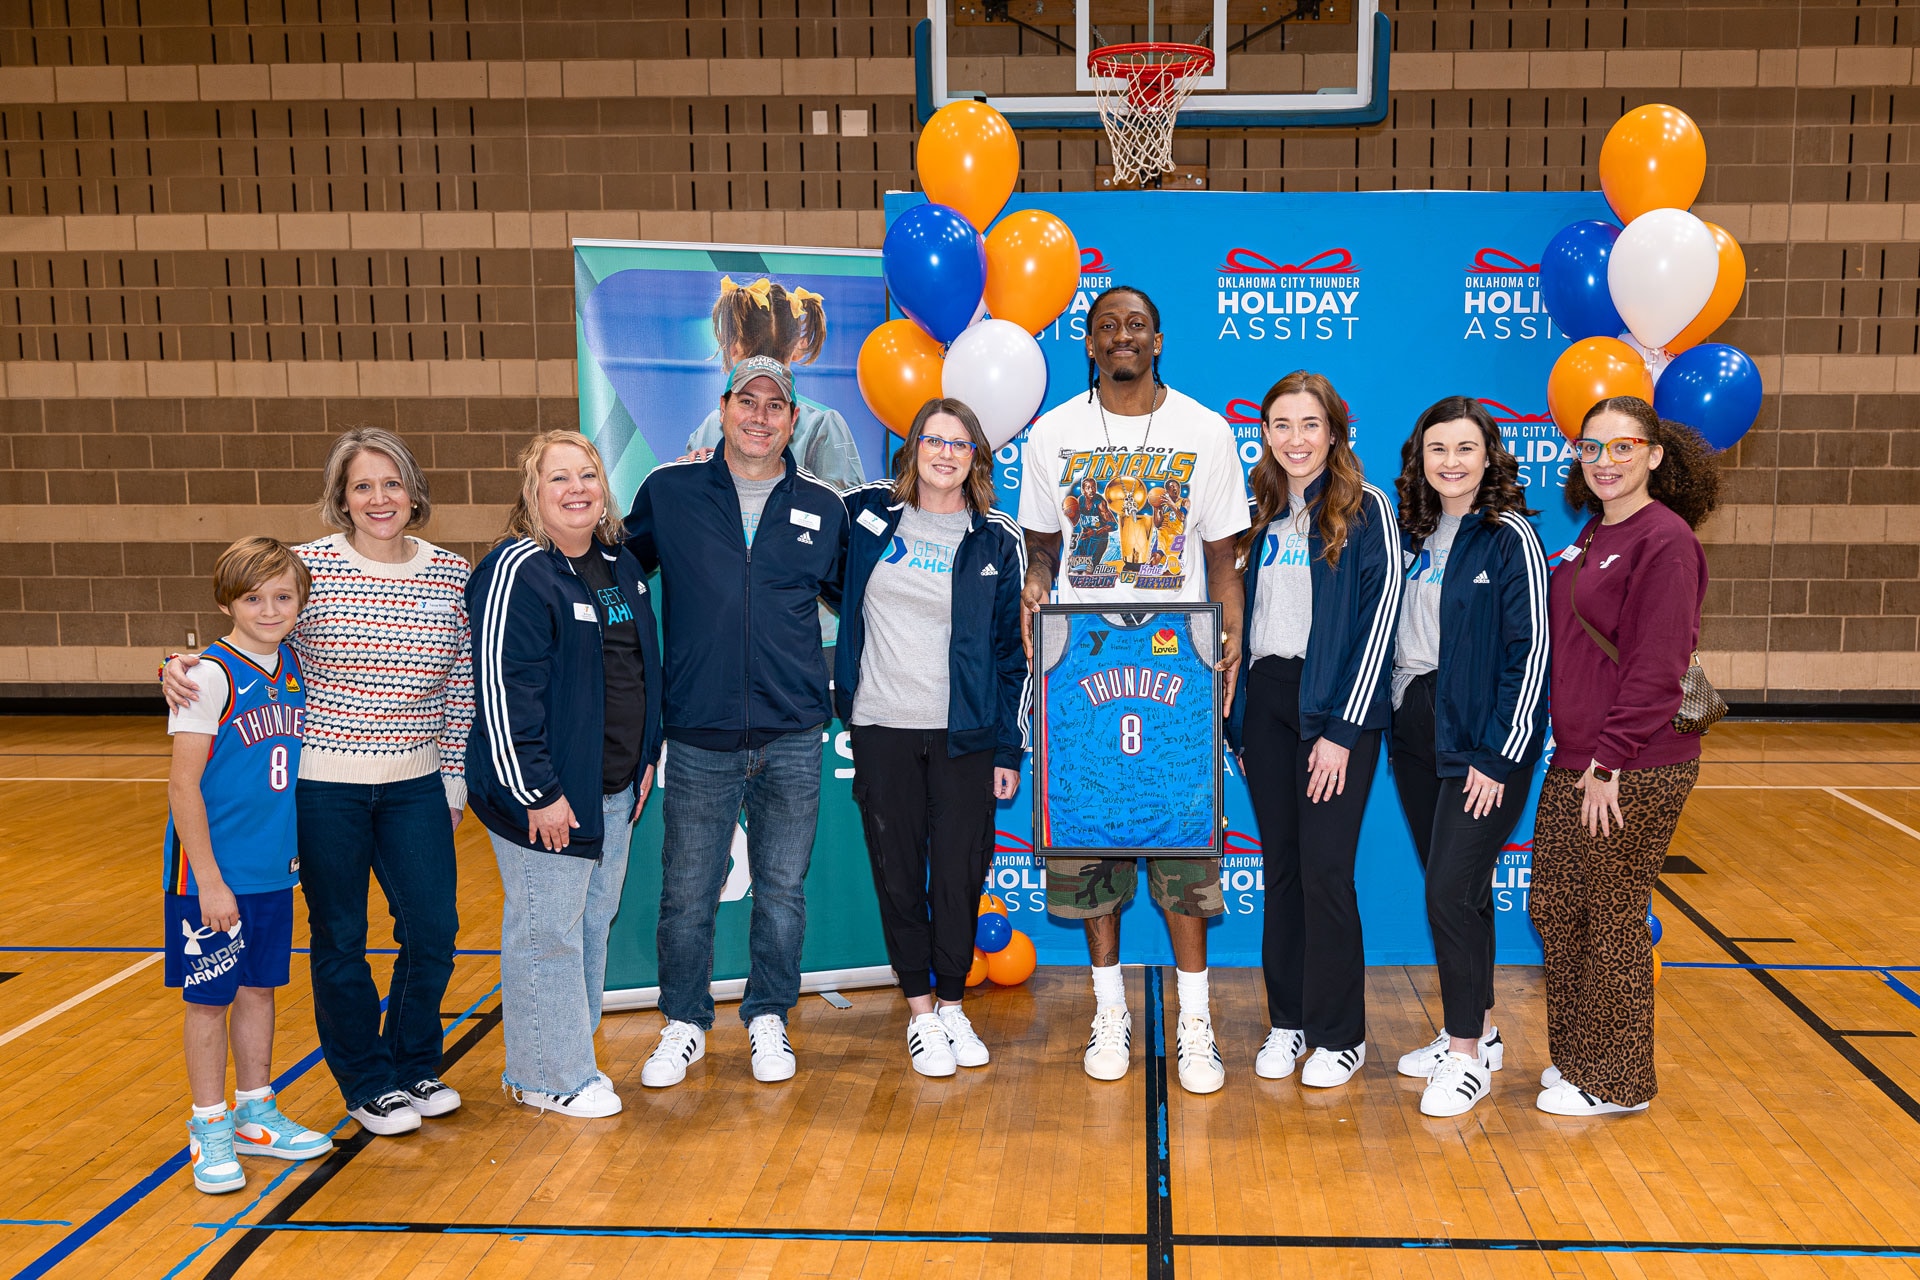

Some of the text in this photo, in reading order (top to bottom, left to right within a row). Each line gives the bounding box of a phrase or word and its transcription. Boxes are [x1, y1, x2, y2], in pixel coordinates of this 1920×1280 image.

[1218, 276, 1361, 289] OKLAHOMA CITY THUNDER
[1465, 276, 1540, 289] OKLAHOMA CI
[1218, 291, 1360, 315] HOLIDAY
[1464, 290, 1549, 314] HOLI
[1218, 316, 1360, 340] ASSIST
[1463, 316, 1570, 340] ASSI
[1522, 426, 1548, 438] CITY
[1095, 446, 1174, 454] NBA 2001
[1060, 451, 1197, 486] FINALS
[913, 540, 955, 563] GETTI
[1171, 535, 1186, 551] 8
[908, 557, 953, 573] AHE
[1121, 573, 1135, 583] VS
[1078, 666, 1184, 707] THUNDER
[232, 703, 305, 748] THUNDE
[1119, 713, 1143, 756] 8
[269, 744, 289, 793] 8
[991, 855, 1031, 867] AHOMA
[1218, 857, 1264, 868] KLAHOMA
[1504, 854, 1528, 865] CITY
[190, 931, 242, 971] UNDE
